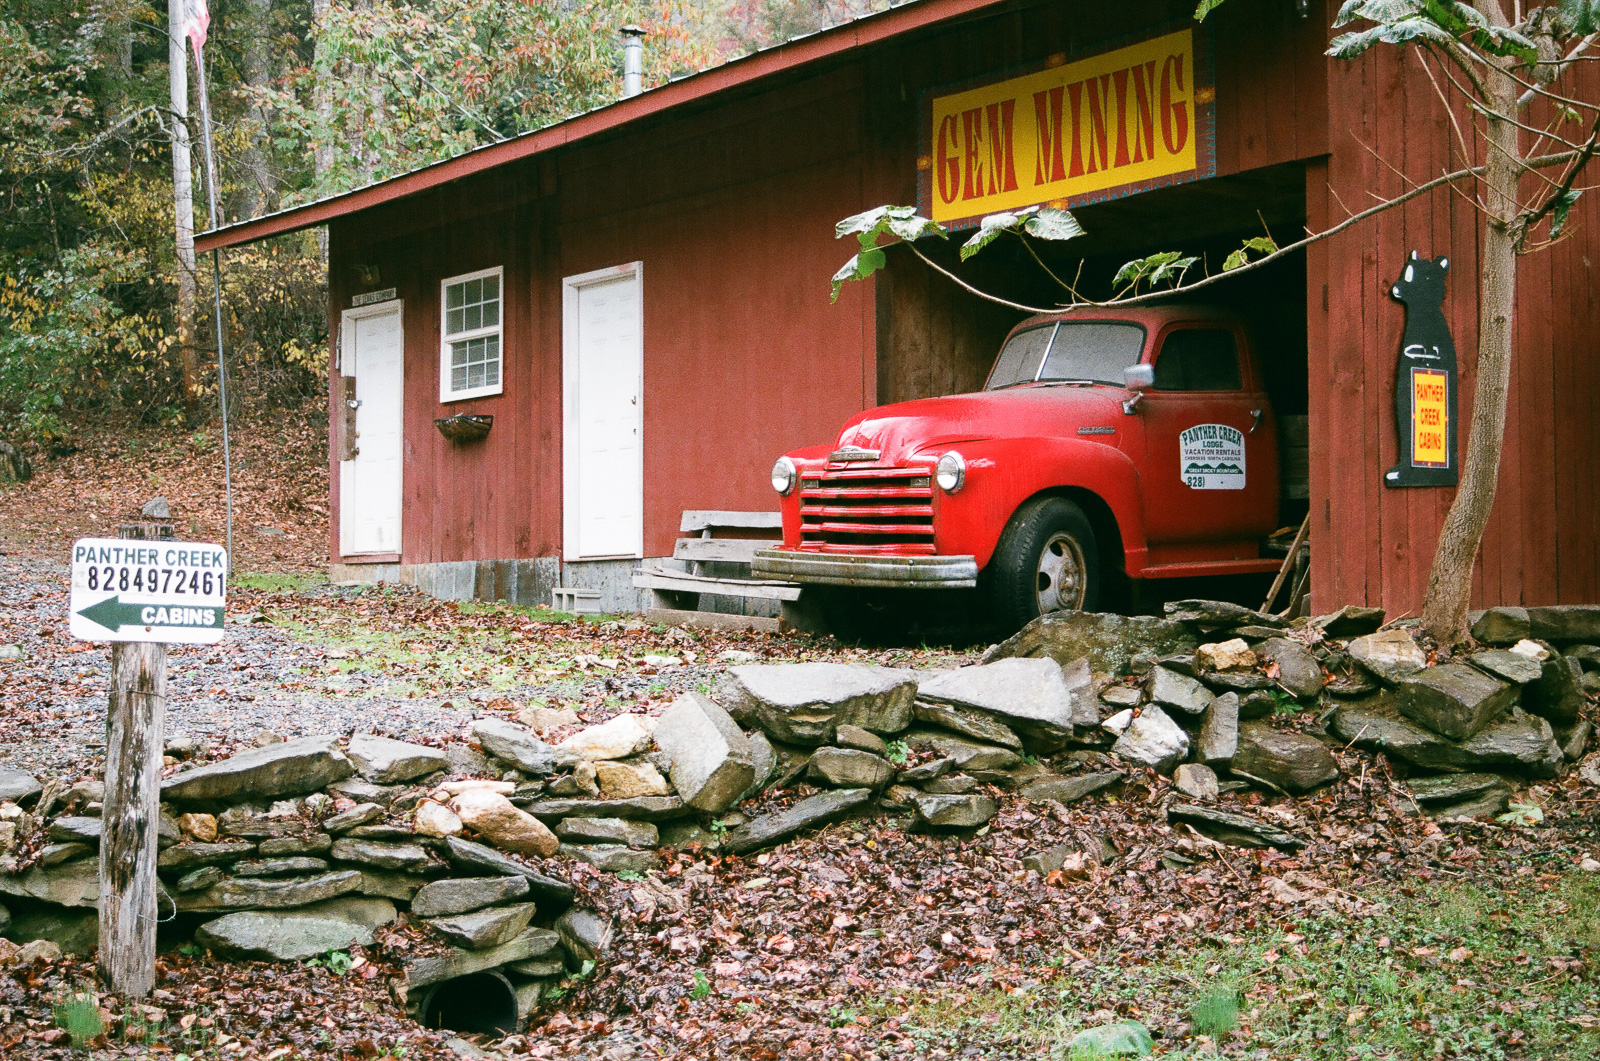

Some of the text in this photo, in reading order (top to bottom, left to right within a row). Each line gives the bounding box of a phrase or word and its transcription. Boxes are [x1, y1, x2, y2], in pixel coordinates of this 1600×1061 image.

[936, 52, 1189, 205] GEM MINING
[1416, 383, 1444, 402] PANTHER
[1420, 408, 1441, 426] CREEK
[1181, 425, 1242, 446] PANTHER CREEK
[1202, 440, 1224, 448] LODGE
[1419, 432, 1442, 450] CABINS
[75, 546, 224, 568] PANTHER CREEK
[88, 565, 224, 597] 8284972461
[140, 606, 216, 626] CABINS
